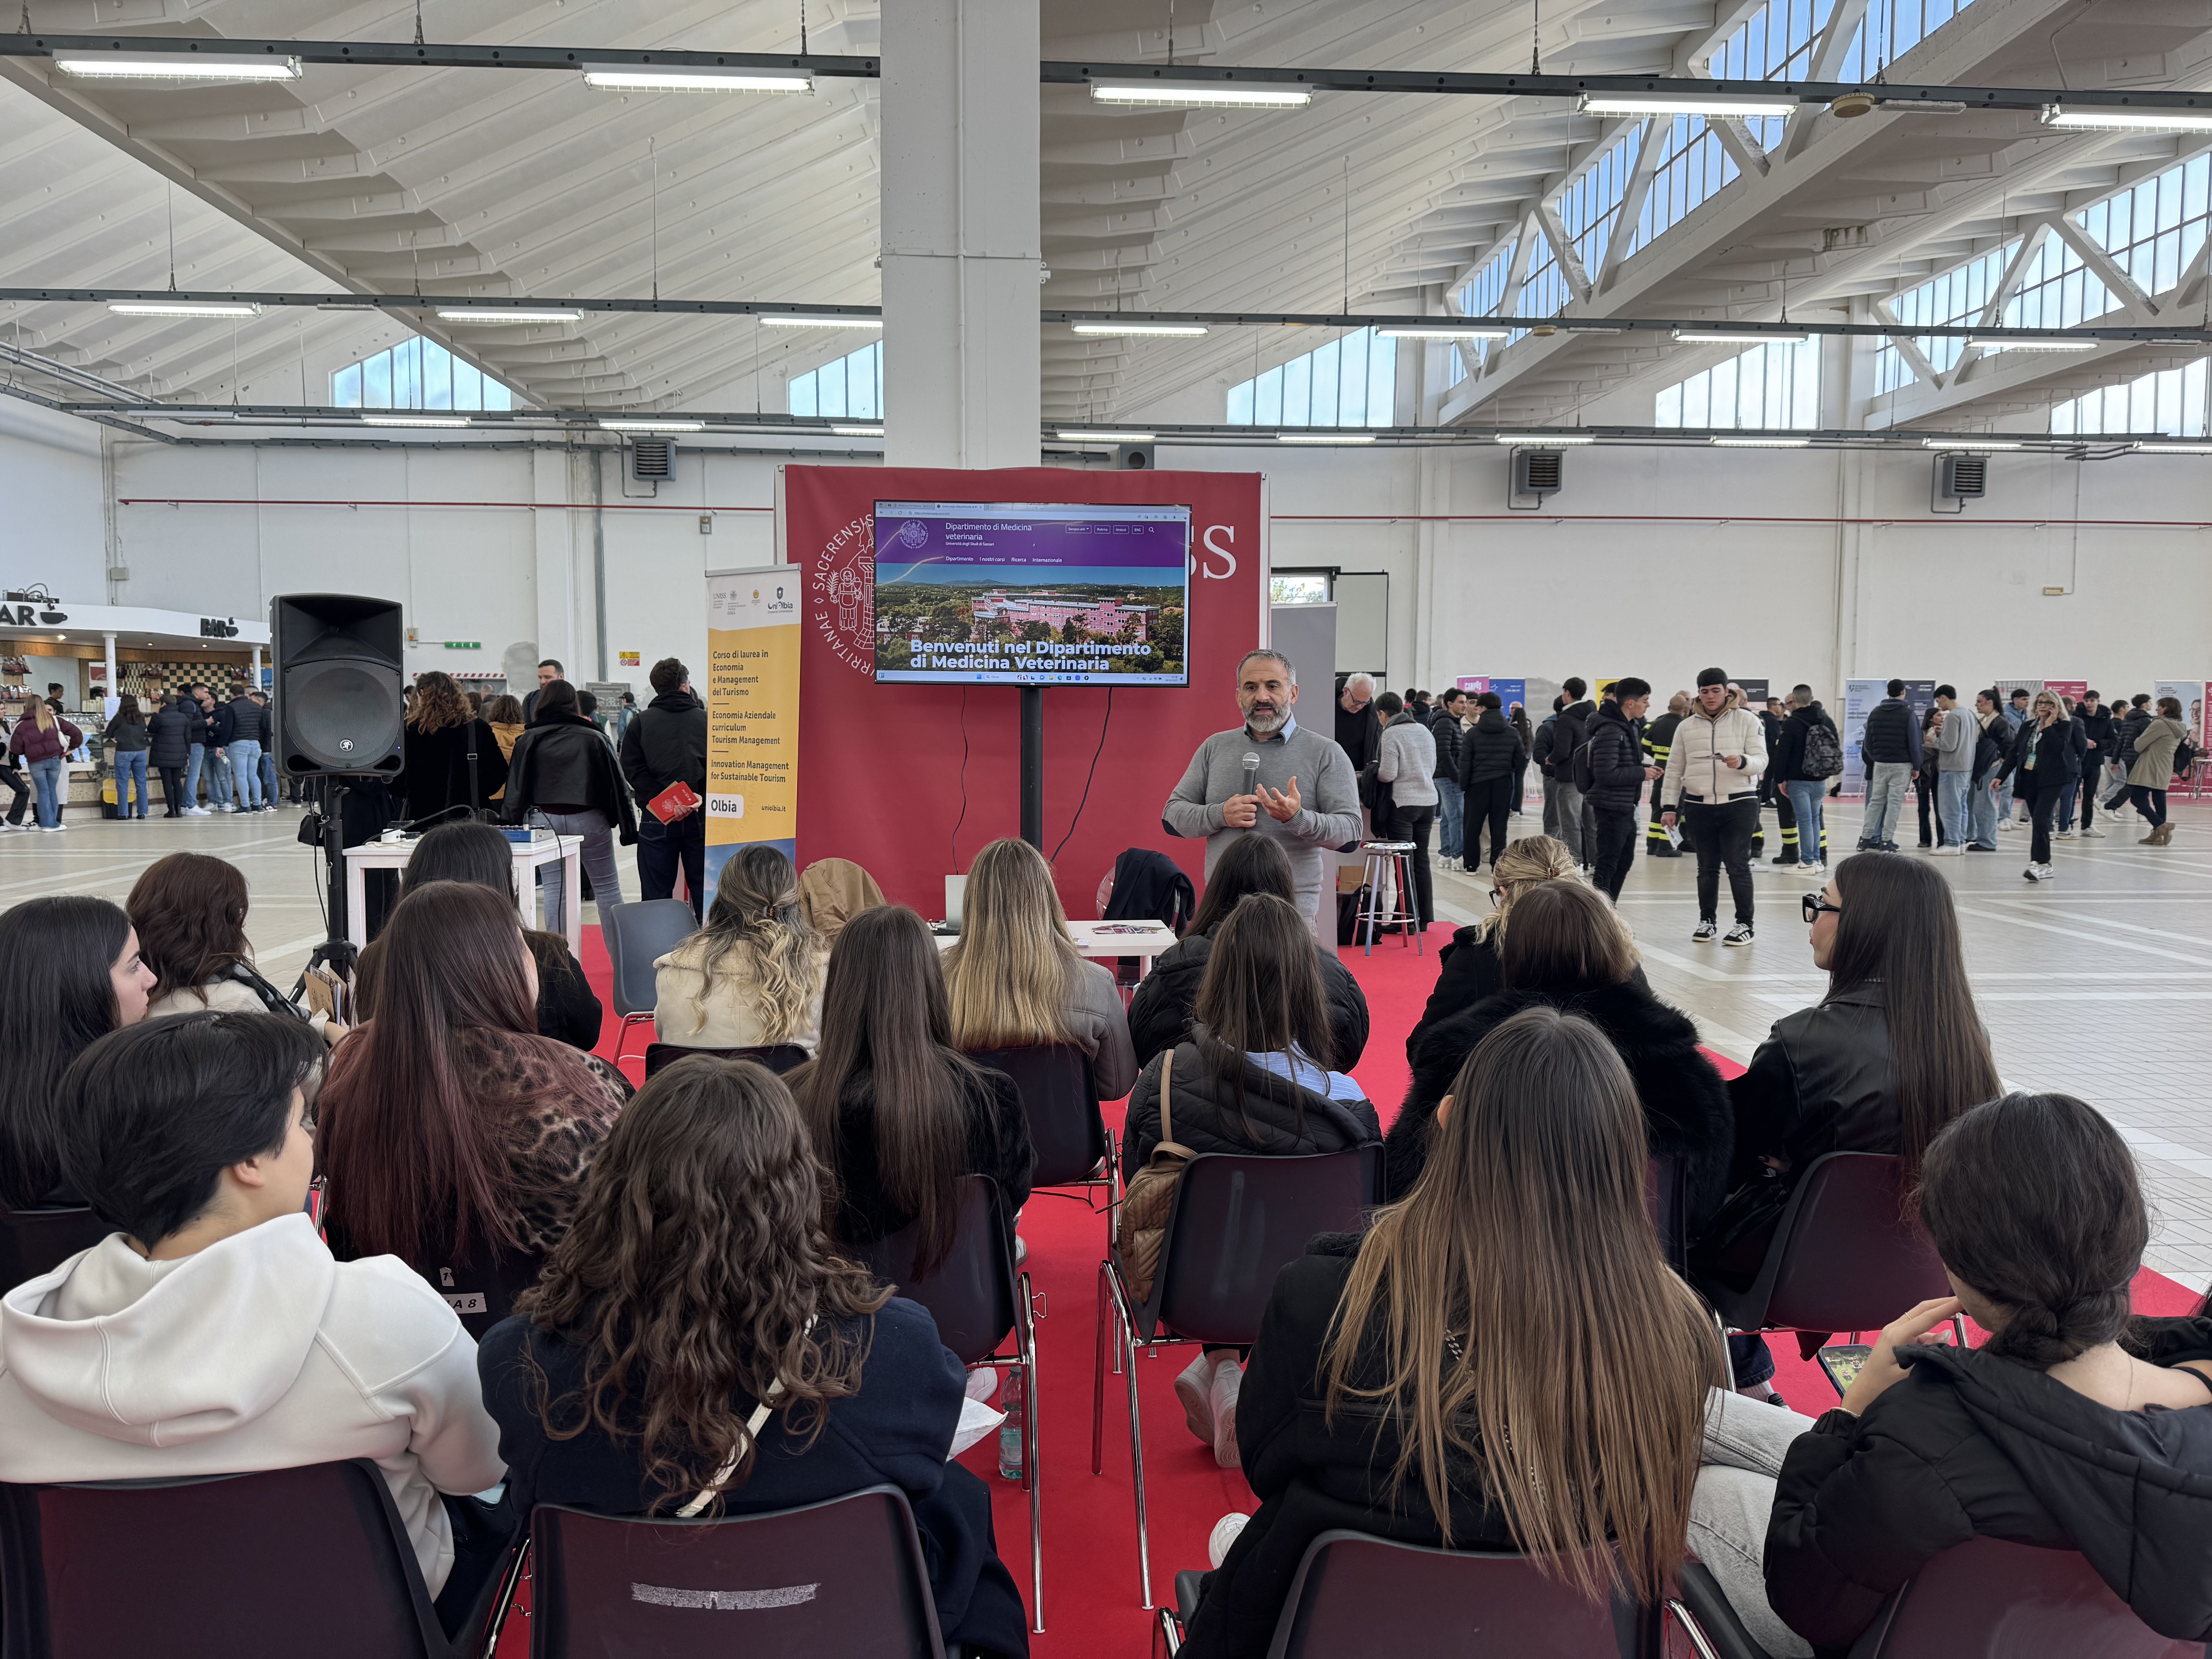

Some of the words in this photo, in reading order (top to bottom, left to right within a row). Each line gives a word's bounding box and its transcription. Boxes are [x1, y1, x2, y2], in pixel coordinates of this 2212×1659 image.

[946, 523, 991, 531] Dipartimento
[813, 514, 874, 591] SACERENSIS
[201, 618, 227, 638] BAR
[815, 611, 874, 676] RRITANAE
[911, 639, 1000, 653] Benvenuti
[1005, 640, 1030, 654] nel
[1036, 640, 1151, 657] Dipartimento
[762, 649, 768, 658] in
[713, 663, 744, 671] Economia
[910, 654, 927, 668] di
[932, 654, 1010, 669] Medicina
[1014, 656, 1109, 670] Veterinaria
[718, 675, 759, 685] Management
[1465, 681, 1482, 690] CAMPUS
[744, 711, 776, 719] Aziendale
[712, 735, 737, 744] Tourism
[739, 736, 780, 745] Management
[711, 759, 745, 768] Innovation
[747, 760, 789, 771] Management
[721, 772, 758, 781] Sustainable
[759, 774, 785, 782] Tourism
[711, 799, 737, 812] Olbia
[468, 1299, 477, 1308] 8
